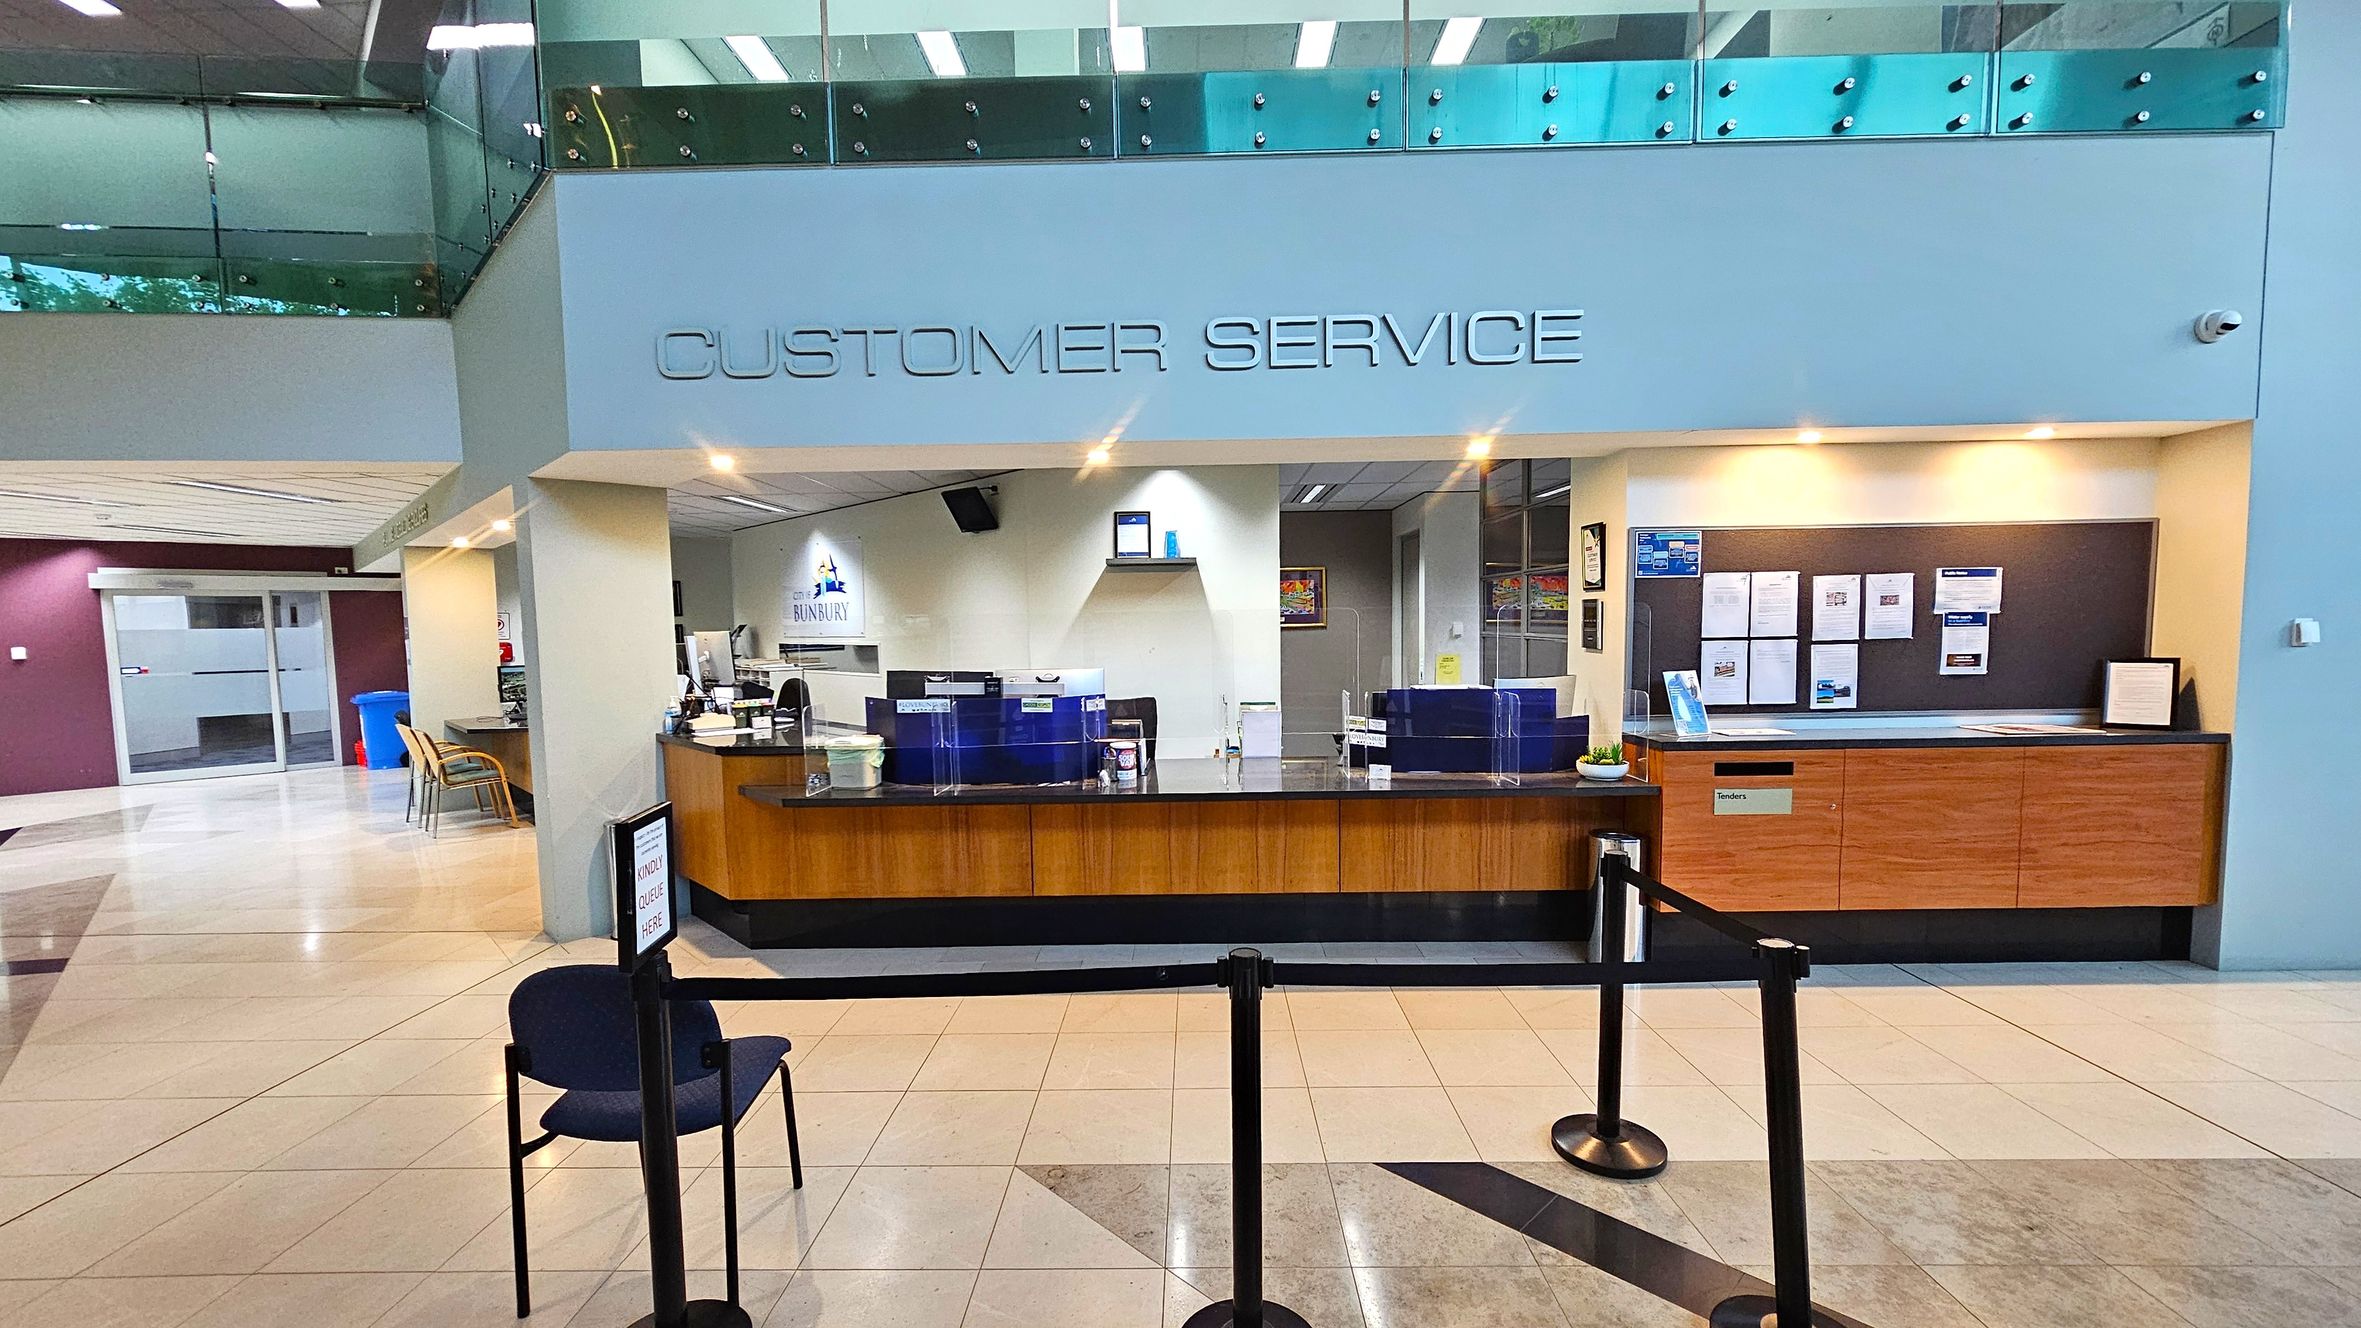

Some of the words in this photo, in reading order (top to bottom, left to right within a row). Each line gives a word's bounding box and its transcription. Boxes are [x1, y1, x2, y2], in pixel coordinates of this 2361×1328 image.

[656, 320, 1168, 380] CUSTOMER
[1204, 309, 1585, 371] SERVICE
[793, 602, 849, 622] BUNBURY
[1717, 792, 1747, 800] Tenders
[637, 855, 663, 882] KINDLY
[638, 882, 664, 910] QUEUE
[641, 912, 663, 940] HERE
